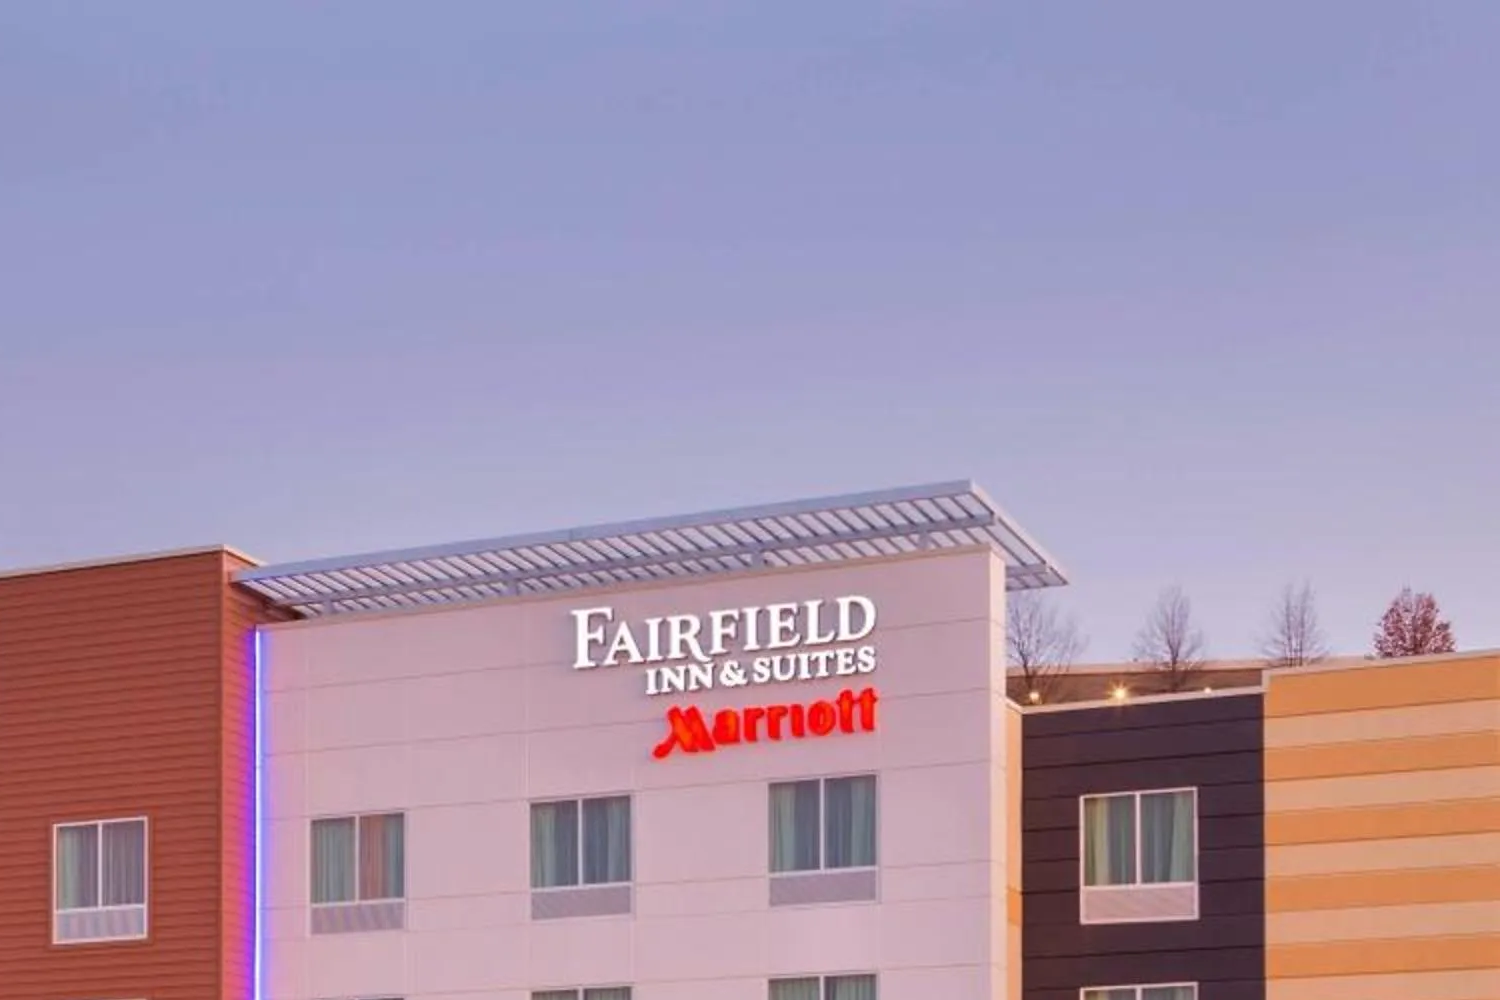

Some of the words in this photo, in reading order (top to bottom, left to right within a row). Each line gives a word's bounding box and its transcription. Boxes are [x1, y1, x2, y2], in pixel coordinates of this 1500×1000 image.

[571, 595, 877, 670] FAIRFIELD
[646, 662, 714, 696] INN
[719, 660, 748, 688] &
[753, 646, 877, 684] SUITES
[653, 687, 878, 760] Marriott
